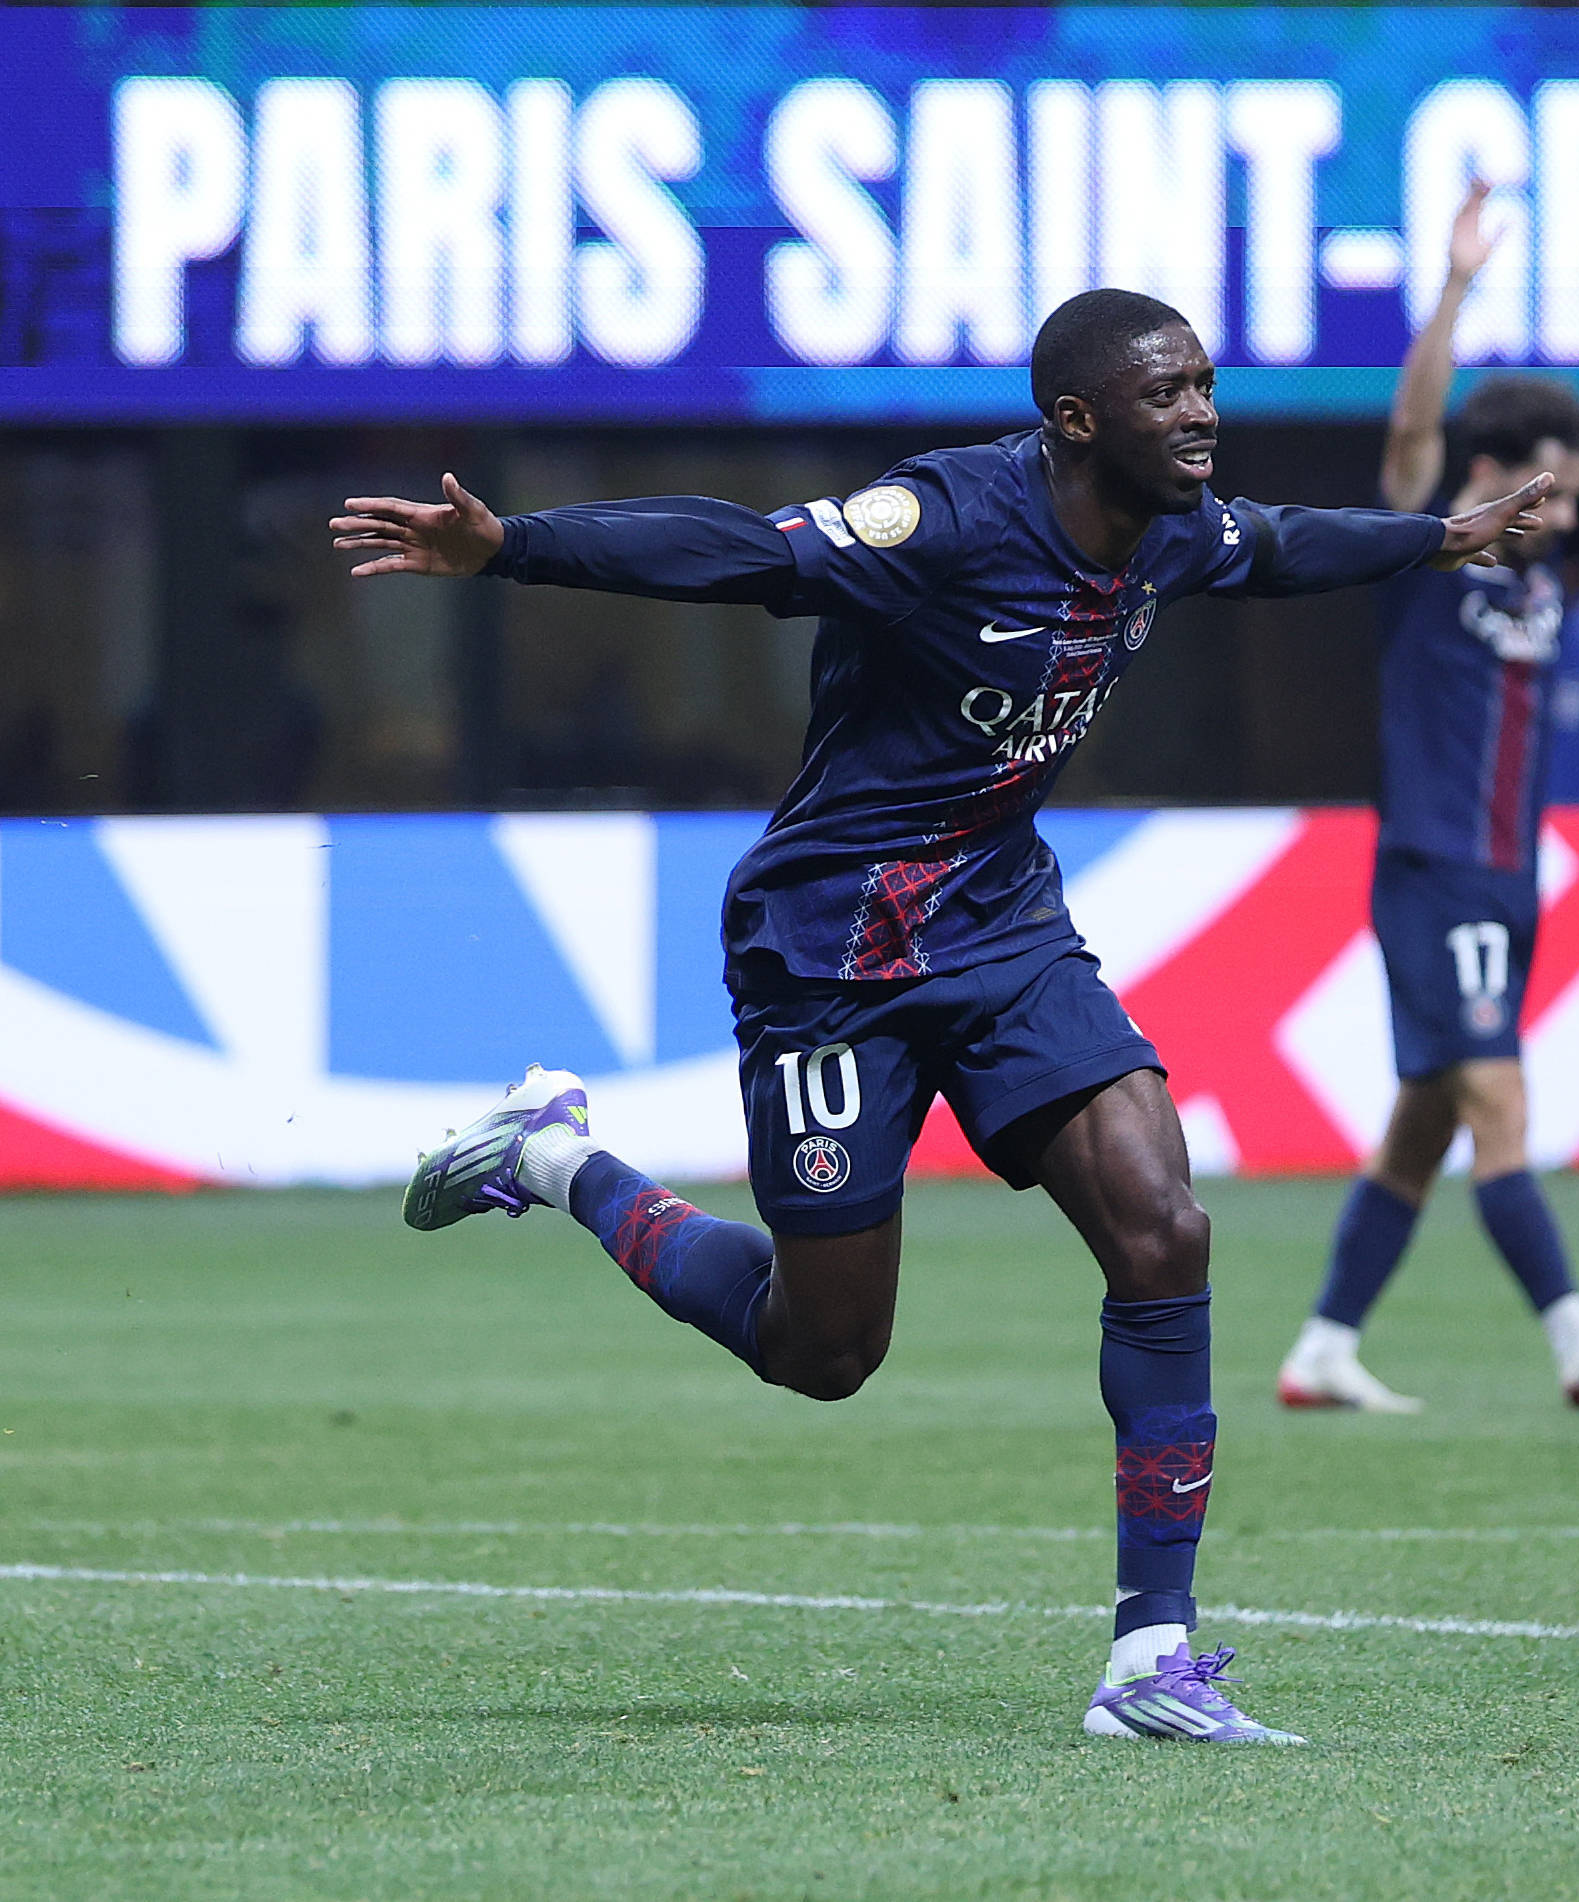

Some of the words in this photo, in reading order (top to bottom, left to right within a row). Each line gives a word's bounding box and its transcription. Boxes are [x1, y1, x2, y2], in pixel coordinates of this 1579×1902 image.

[112, 74, 707, 368] PARIS
[960, 676, 1119, 737] QATA
[1446, 920, 1509, 1000] 17
[774, 1042, 861, 1134] 10
[800, 1138, 838, 1154] PARIS
